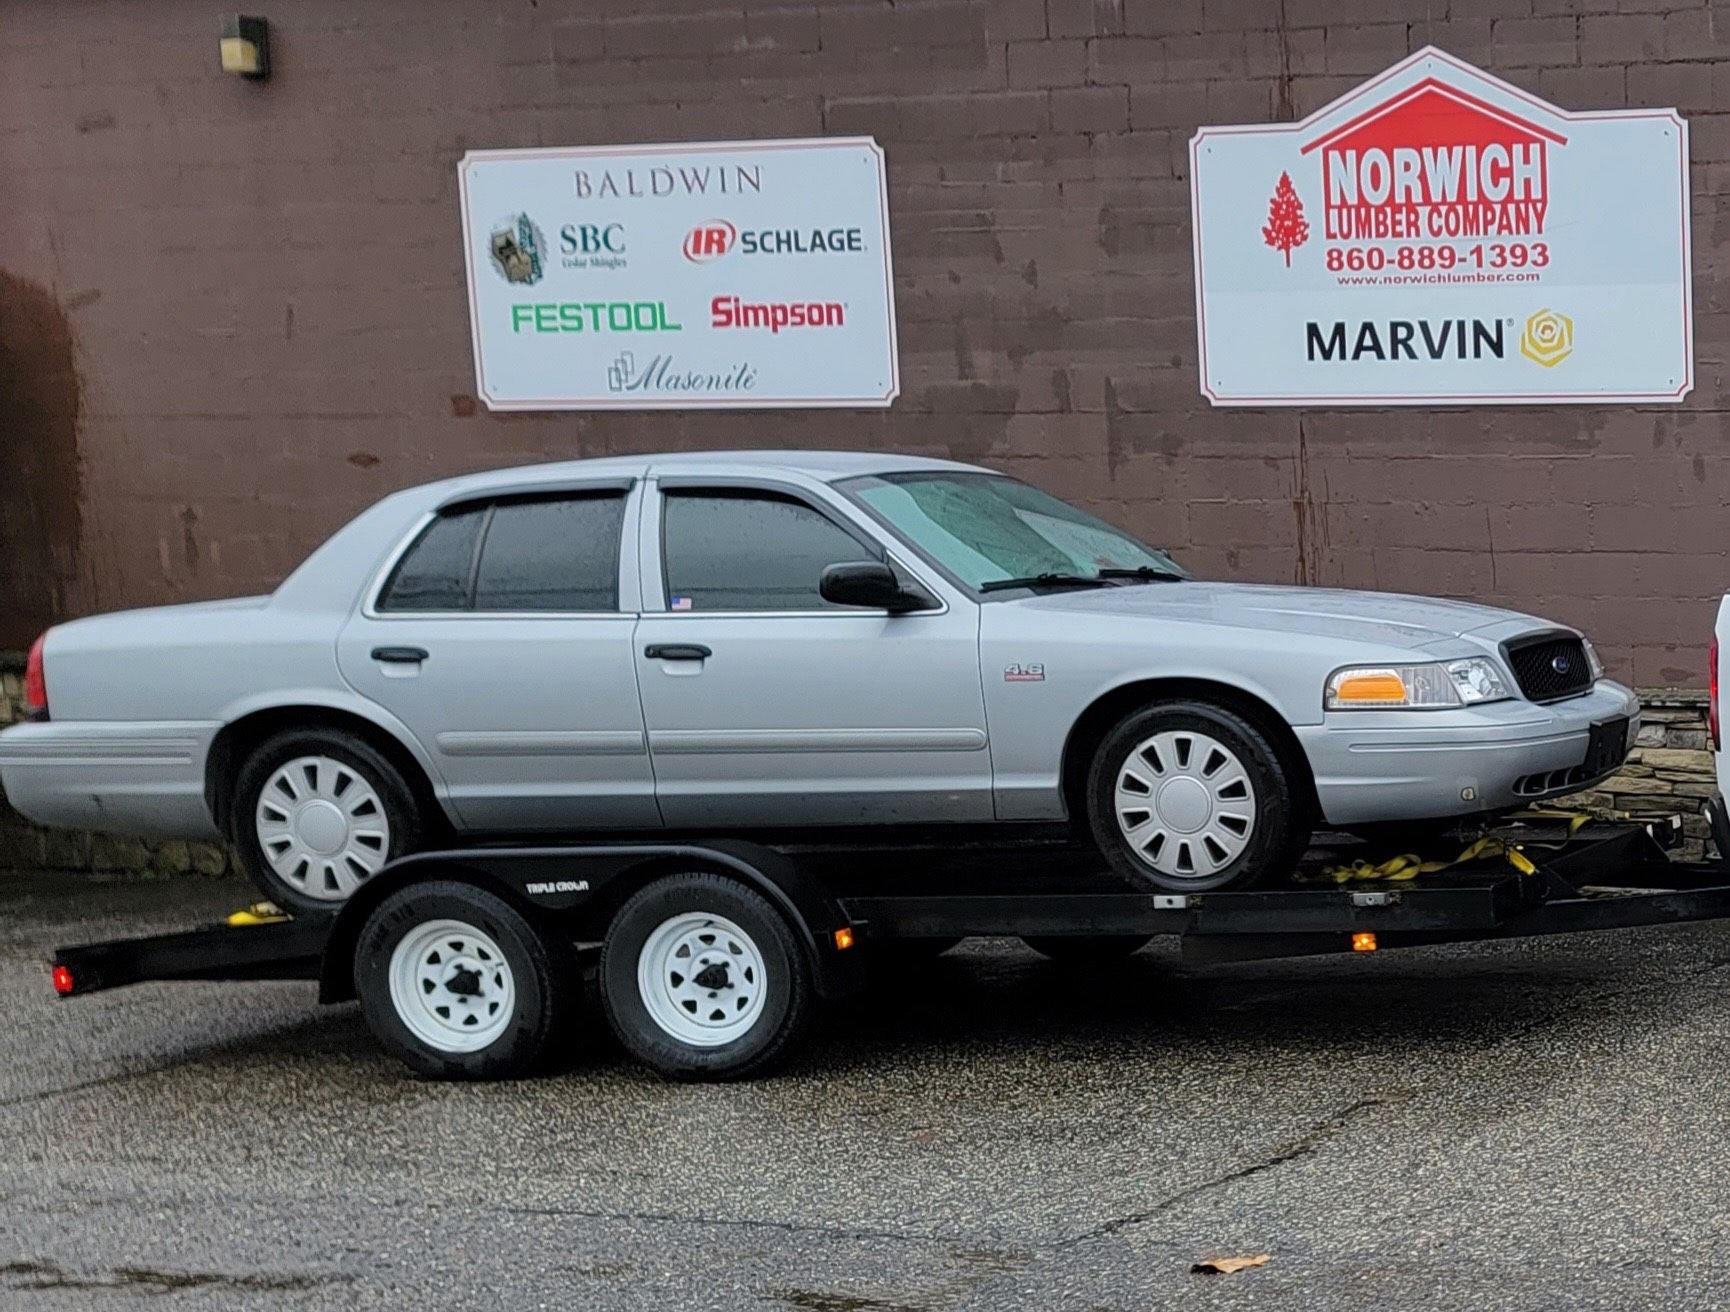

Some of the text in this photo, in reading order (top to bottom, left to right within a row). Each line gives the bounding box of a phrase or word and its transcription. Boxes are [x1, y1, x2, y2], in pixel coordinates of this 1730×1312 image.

[575, 165, 762, 199] BALDWIN
[1328, 143, 1543, 206] NORWICH
[1325, 202, 1548, 240] LUMBER COMPANY
[559, 223, 626, 255] SBC
[691, 229, 863, 256] IR SCHLAGE
[1326, 243, 1550, 271] 860-889-1393
[1337, 272, 1541, 285] www.norwichlumber.com
[512, 302, 682, 333] FESTOOL
[711, 297, 845, 334] Simpson
[1306, 319, 1505, 361] MARVIN
[626, 354, 757, 391] Masonite
